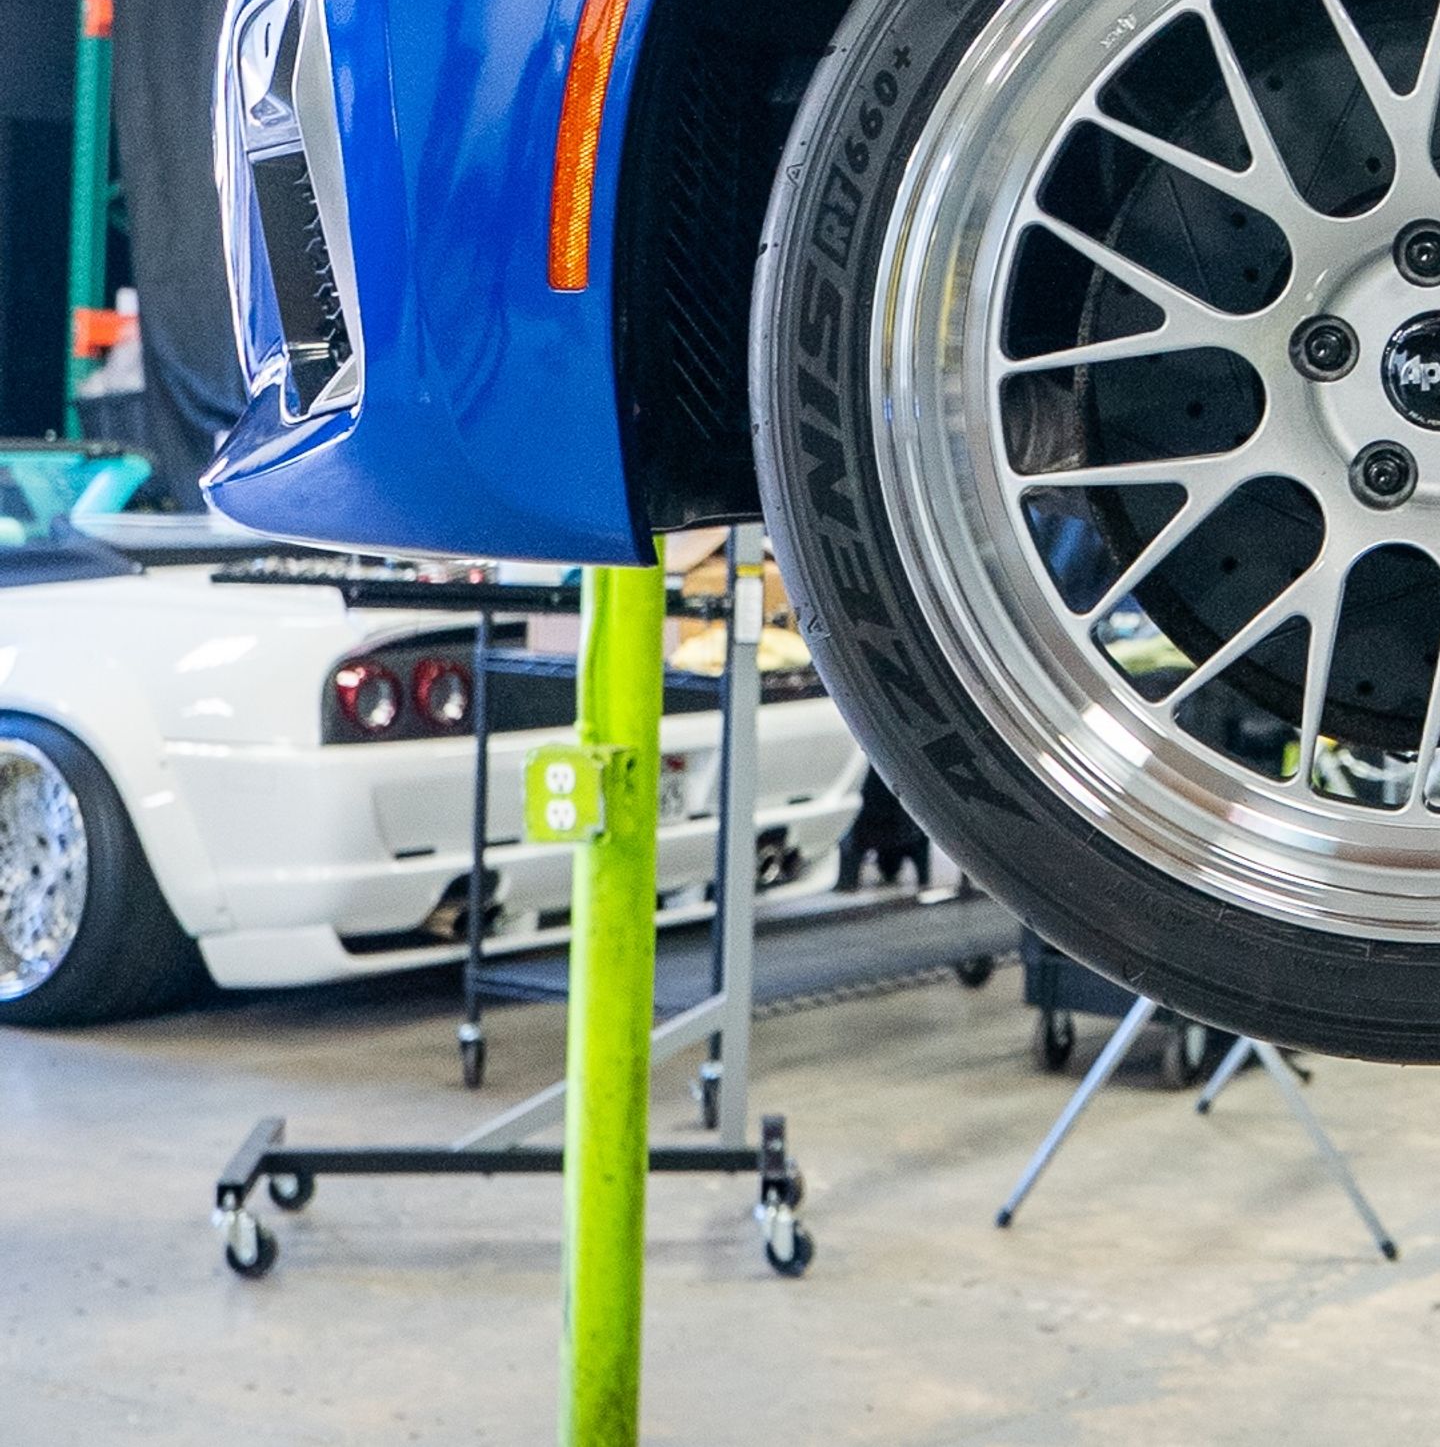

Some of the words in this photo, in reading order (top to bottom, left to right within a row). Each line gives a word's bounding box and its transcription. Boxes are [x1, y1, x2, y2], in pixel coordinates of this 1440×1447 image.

[1100, 14, 1137, 48] Apex
[811, 44, 912, 271] RT660+
[800, 257, 1041, 824] AZENIS
